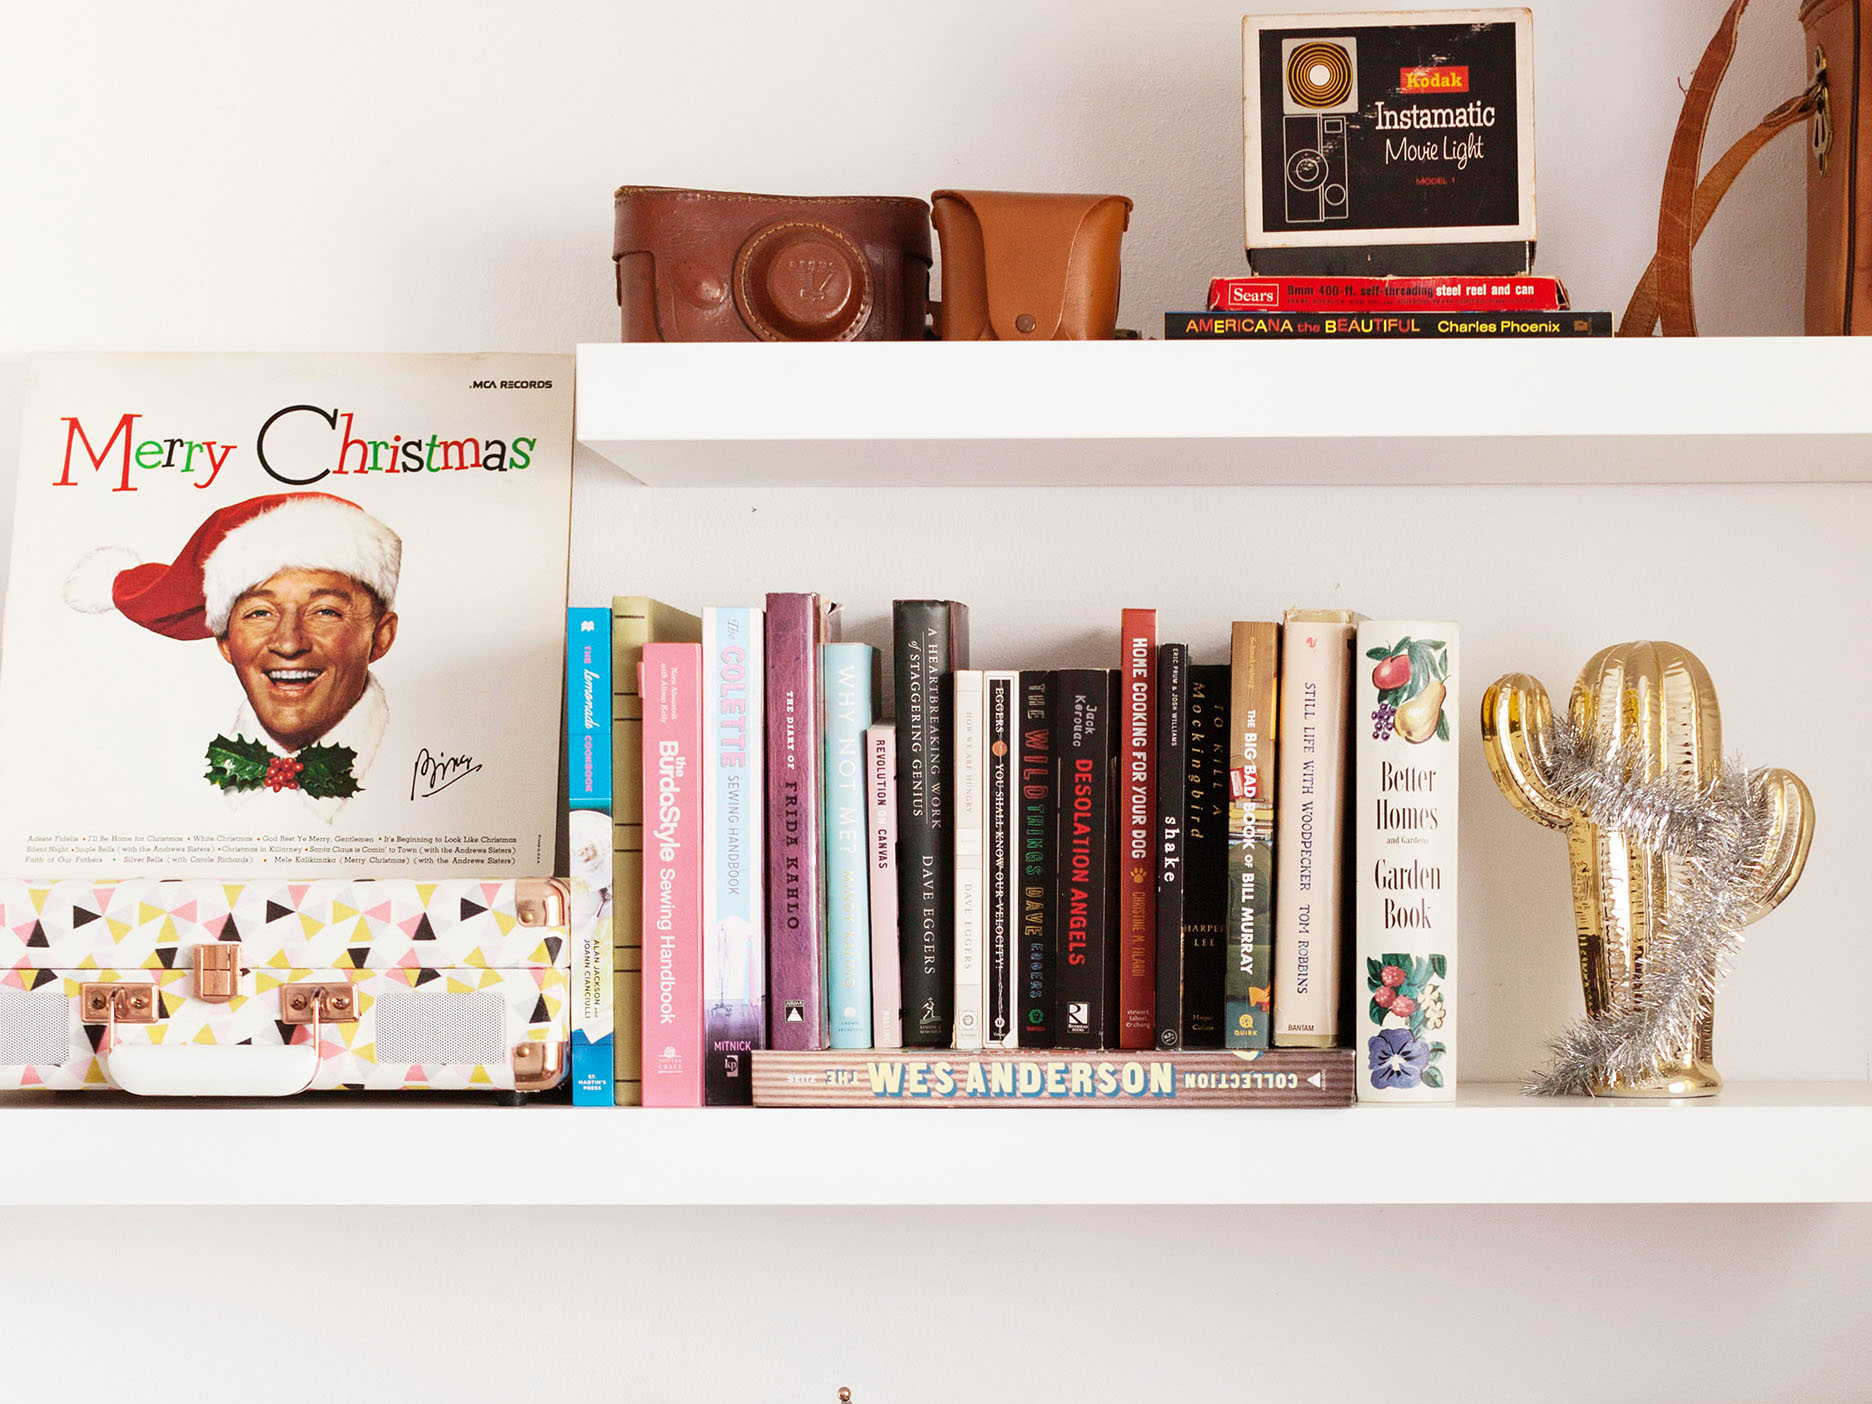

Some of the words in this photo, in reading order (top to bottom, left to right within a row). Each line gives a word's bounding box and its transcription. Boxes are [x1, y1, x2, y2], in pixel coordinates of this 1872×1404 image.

[1406, 72, 1462, 88] Kodak
[1375, 100, 1495, 130] Instamatic
[1385, 136, 1439, 164] Movie
[1443, 132, 1484, 170] Light
[1233, 288, 1274, 302] Sears
[1288, 285, 1314, 296] 8mm
[1361, 284, 1433, 298] self-threading
[1436, 284, 1461, 296] steel
[1466, 284, 1487, 296] reel
[1491, 283, 1510, 295] and
[1515, 285, 1534, 295] can
[1185, 319, 1294, 333] AMERICANA
[1297, 322, 1320, 333] the
[1325, 319, 1420, 333] BEAUTIFUL
[1438, 320, 1496, 333] Charles
[1501, 320, 1560, 333] Phoenix
[473, 380, 497, 389] MCA
[500, 380, 553, 389] RECORDS
[52, 413, 237, 492] Merry
[256, 404, 537, 485] Christmas
[728, 618, 740, 640] The
[908, 640, 921, 652] of
[928, 627, 938, 637] A
[584, 645, 592, 664] THE
[1132, 637, 1148, 679] HOME
[584, 668, 600, 730] lemonade
[720, 646, 746, 768] COLETTE
[837, 665, 856, 722] WHY
[910, 654, 922, 753] STAGGERING
[928, 644, 941, 775] HEARTBREAKING
[995, 687, 1005, 733] EGGERS
[1027, 683, 1046, 720] THE
[1304, 682, 1316, 721] STILL
[787, 717, 795, 751] DIARY
[1072, 694, 1086, 747] Kerouac
[1085, 704, 1098, 735] Jack
[1132, 682, 1148, 747] COOKING
[1214, 704, 1224, 729] TO
[1247, 709, 1256, 728] THE
[1244, 733, 1257, 760] BIG
[1303, 727, 1316, 753] LIFE
[584, 735, 593, 792] COOKBOOK
[675, 757, 686, 778] the
[787, 755, 795, 770] OF
[838, 738, 857, 792] NOT
[876, 739, 887, 806] REVOLUTION
[995, 764, 1005, 790] YOU
[1024, 729, 1050, 800] WILD
[1132, 751, 1147, 783] FOR
[1188, 682, 1205, 839] Mockingbird
[1213, 743, 1224, 790] KILL
[1302, 760, 1315, 795] WITH
[1382, 761, 1437, 792] Better
[653, 741, 681, 862] BurdaStyle
[727, 775, 740, 823] SEWING
[912, 759, 923, 817] GENIUS
[1243, 766, 1257, 798] BAD
[785, 781, 798, 846] FRIDA
[877, 810, 887, 825] ON
[930, 782, 942, 829] WORK
[995, 791, 1005, 831] SHALL
[1072, 759, 1093, 882] DESOLATION
[1131, 786, 1147, 826] YOUR
[1212, 804, 1223, 816] A
[1376, 799, 1438, 830] Homes
[397, 836, 433, 845] Beginning
[839, 807, 857, 854] ME?
[1025, 804, 1045, 876] THINGS
[1131, 829, 1147, 859] DOG
[1242, 802, 1256, 850] BOOK
[1386, 836, 1400, 844] and
[1401, 836, 1429, 845] Gardens
[727, 828, 740, 895] HANDBOOK
[878, 829, 888, 869] CANVAS
[995, 833, 1005, 868] KNOW
[1163, 816, 1180, 883] shake
[1244, 854, 1253, 868] OF
[1300, 801, 1313, 891] WOODPECKER
[786, 857, 799, 929] KAHLO
[922, 856, 934, 900] DAVE
[995, 872, 1005, 898] OUR
[1241, 873, 1255, 903] BILL
[1374, 859, 1441, 890] Garden
[656, 868, 676, 931] Sewing
[1024, 886, 1044, 937] DAVE
[1299, 904, 1311, 934] TOM
[1384, 898, 1432, 929] Book
[923, 908, 935, 975] EGGERS
[1068, 888, 1089, 966] ANGELS
[1240, 907, 1254, 975] MURRAY
[660, 935, 676, 1024] Handbook
[1029, 943, 1044, 999] EGGERS
[1297, 941, 1309, 994] ROBBINS
[714, 1041, 751, 1051] MITNICK
[1288, 1024, 1315, 1032] BANTAM
[824, 1069, 861, 1086] THE
[866, 1062, 958, 1098] WES
[965, 1062, 1176, 1098] ANDERSON
[1183, 1071, 1298, 1089] COLLECTION
